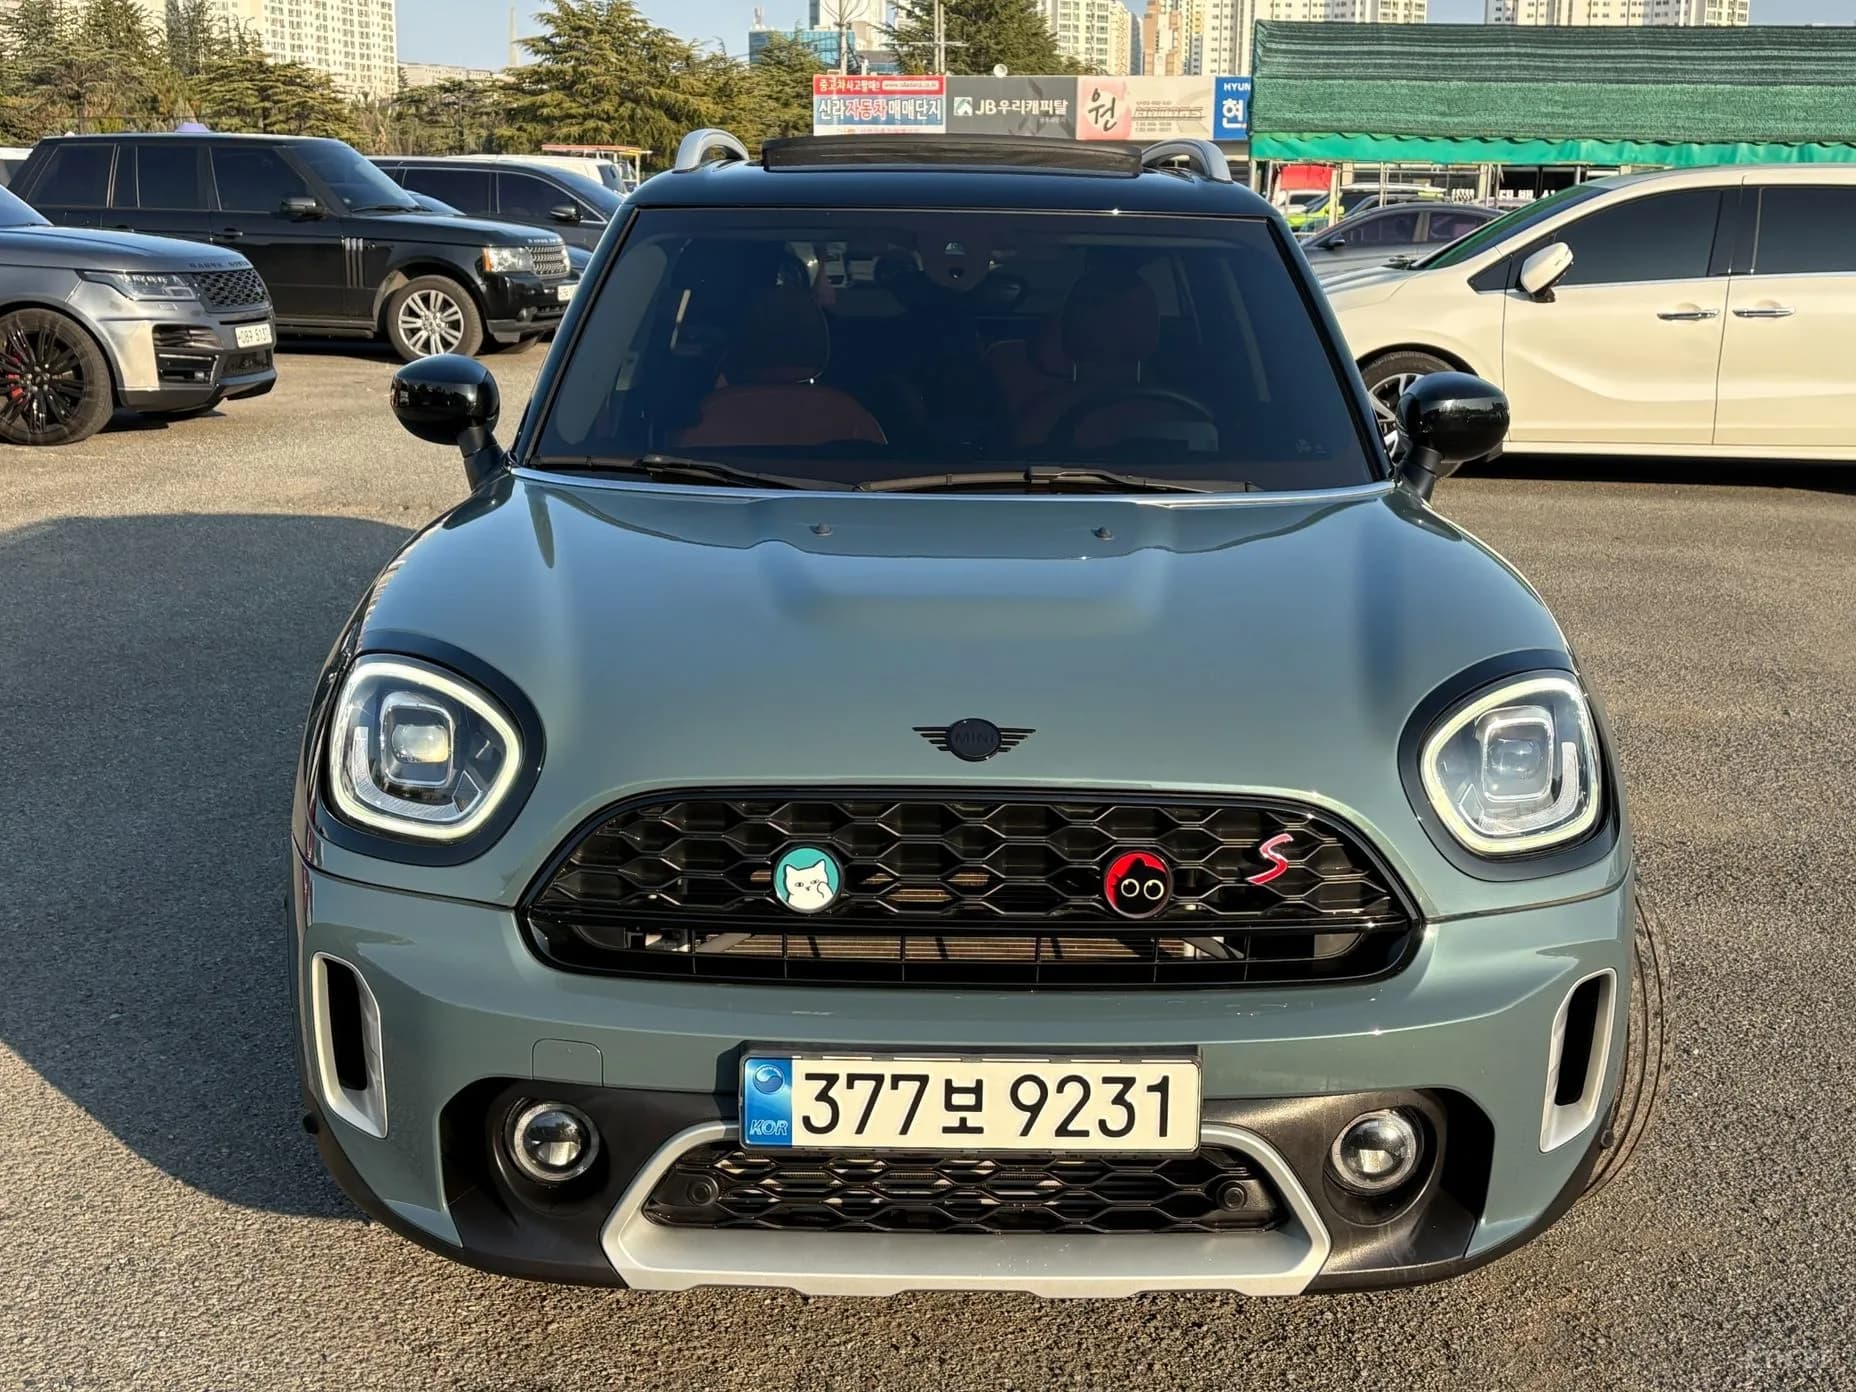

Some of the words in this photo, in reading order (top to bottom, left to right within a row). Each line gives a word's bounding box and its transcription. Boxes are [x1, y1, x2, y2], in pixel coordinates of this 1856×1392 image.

[1088, 88, 1117, 132] 원
[955, 732, 994, 744] MINI
[1245, 833, 1294, 885] S
[749, 1119, 788, 1136] KOR
[801, 1073, 984, 1135] 377보
[1010, 1074, 1171, 1138] 9231
